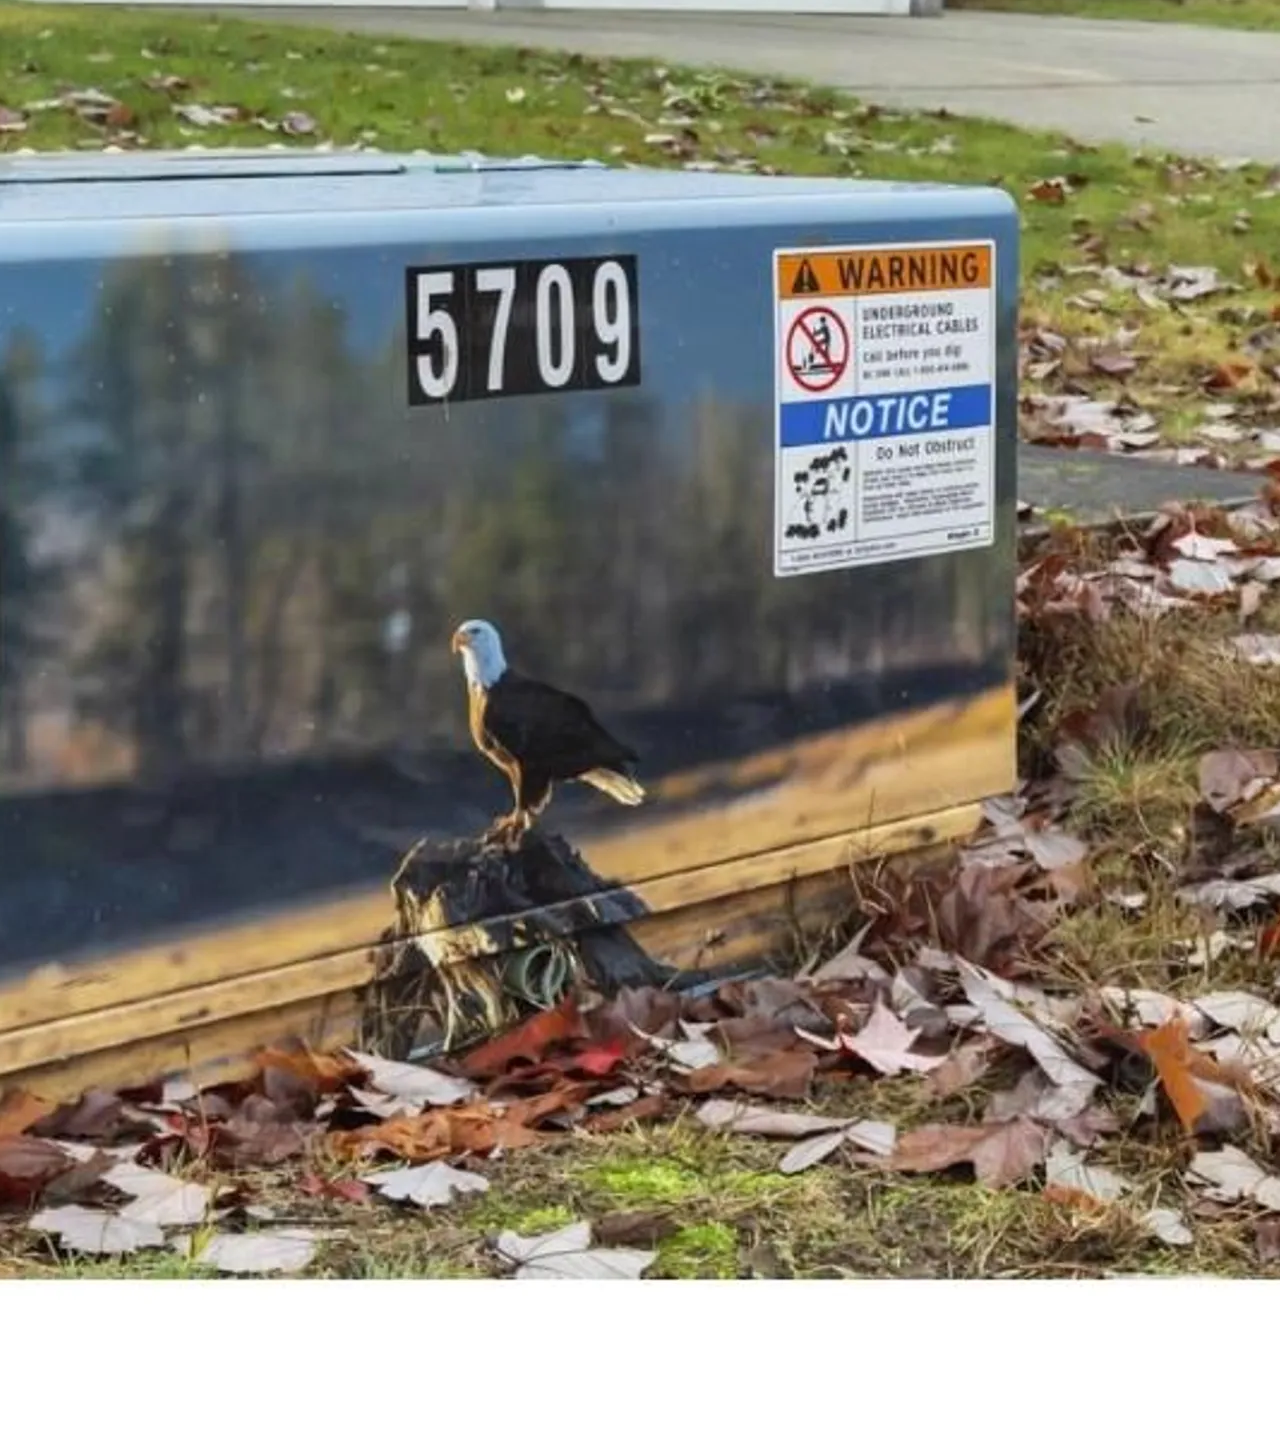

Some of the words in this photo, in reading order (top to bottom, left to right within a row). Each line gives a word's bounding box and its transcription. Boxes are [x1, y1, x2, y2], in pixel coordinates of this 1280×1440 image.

[837, 252, 979, 290] WARNING
[862, 302, 953, 322] UNDERGROUND
[416, 260, 631, 398] 5709
[862, 322, 931, 339] ELECTRICAL
[936, 317, 979, 335] CABLES
[823, 393, 952, 439] NOTICE
[876, 446, 893, 460] Do
[899, 443, 920, 457] Not
[925, 438, 975, 455] Obstruct
